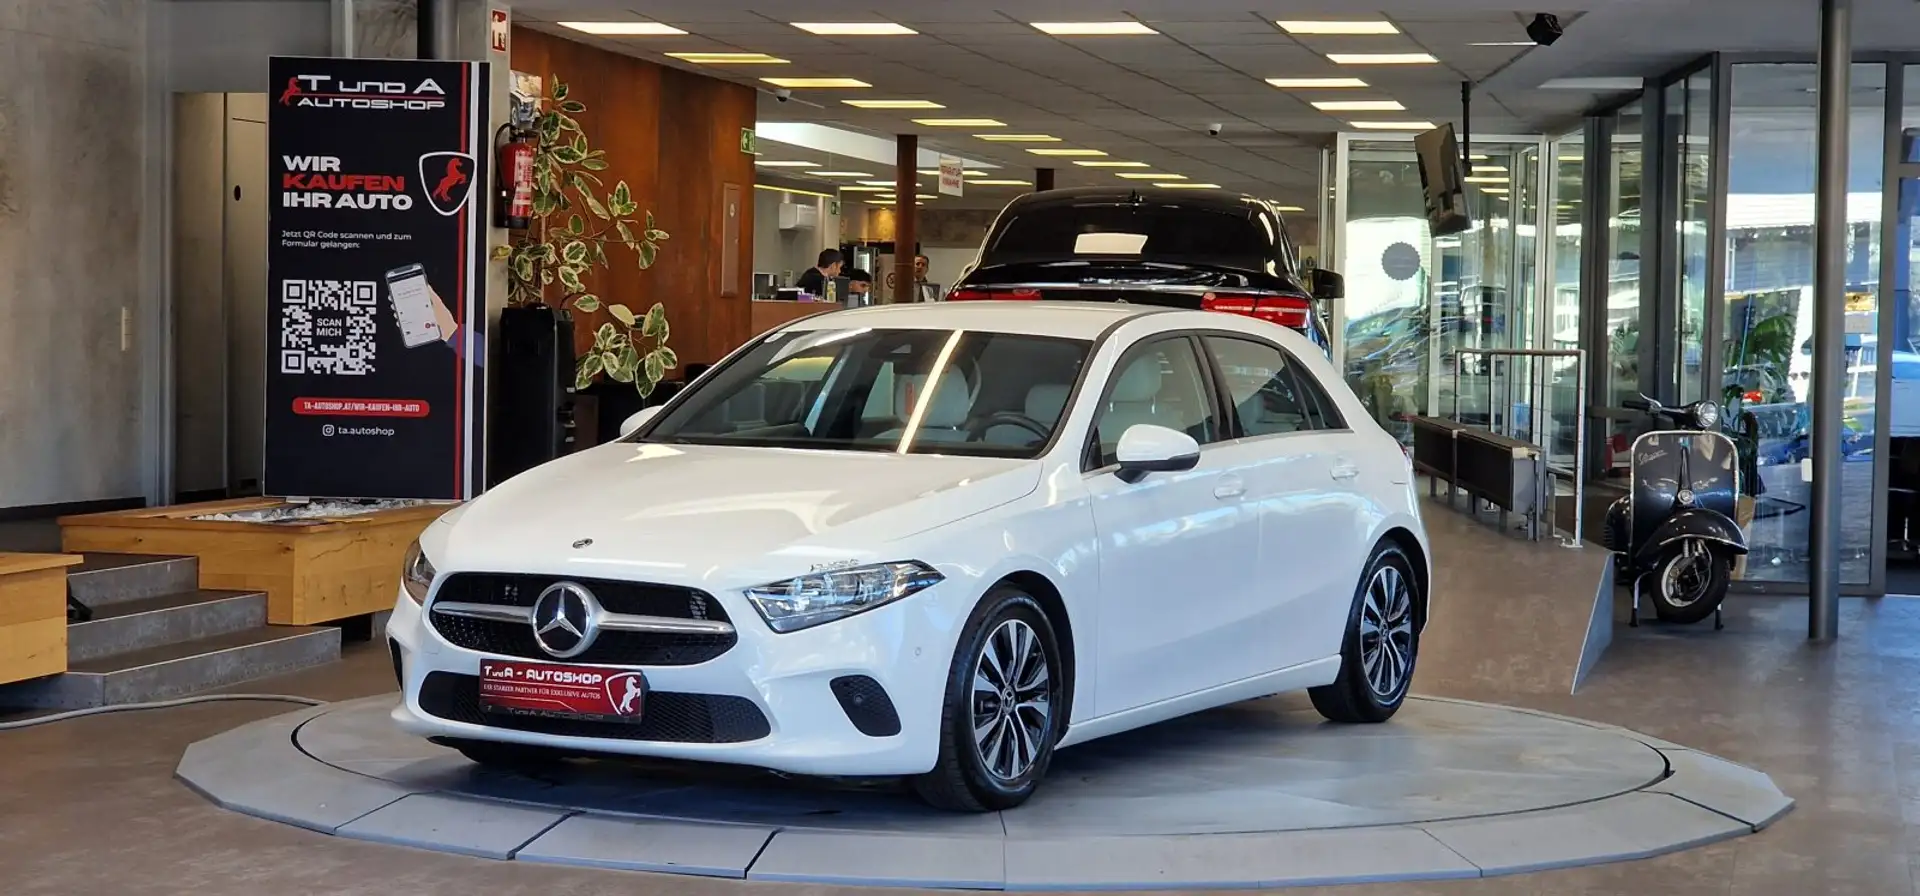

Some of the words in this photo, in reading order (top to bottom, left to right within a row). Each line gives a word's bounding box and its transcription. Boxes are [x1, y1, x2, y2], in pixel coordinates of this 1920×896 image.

[298, 74, 331, 91] T
[412, 78, 445, 95] A
[297, 98, 445, 110] AUTOSHOP
[283, 155, 341, 172] WIR
[283, 174, 405, 191] KAUFEN
[283, 192, 332, 208] IHR
[336, 194, 413, 210] AUTO
[282, 230, 302, 238] Jetzt
[303, 231, 316, 239] QR
[317, 231, 339, 239] Code
[375, 232, 392, 240] und
[282, 239, 319, 247] Formular
[320, 240, 360, 250] gelangen:
[316, 317, 342, 327] SCAN
[316, 327, 342, 337] MICH
[338, 426, 395, 437] ta.autoshop
[526, 669, 603, 684] AUTOSHOP
[514, 686, 538, 694] PARTNER
[539, 687, 550, 695] FÜR
[550, 688, 580, 698] EXKLUSIVE
[580, 691, 601, 700] AUTOS
